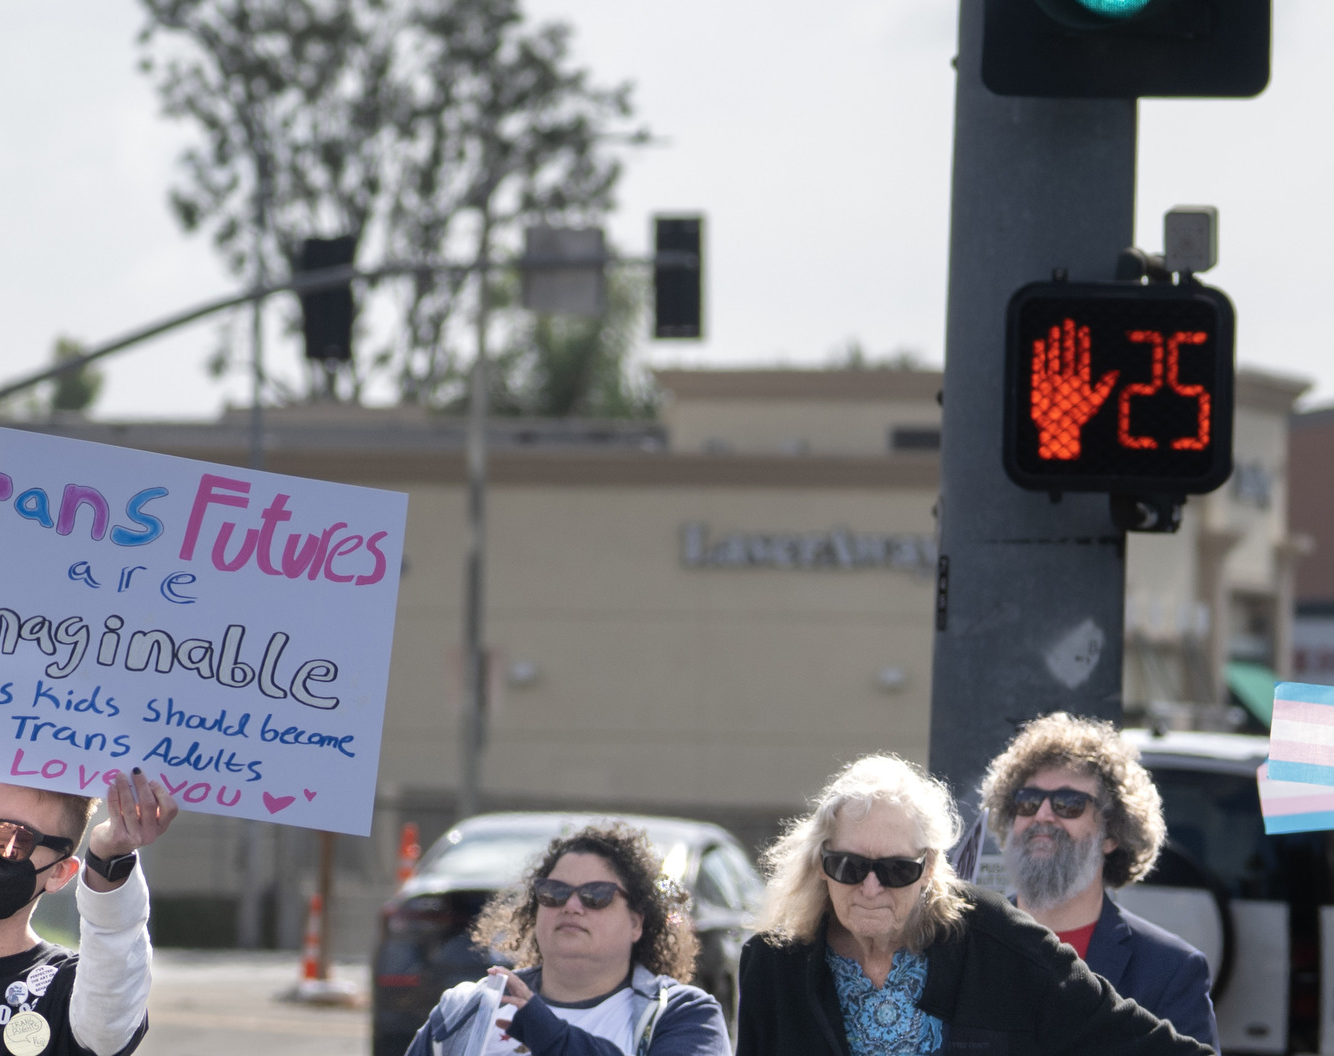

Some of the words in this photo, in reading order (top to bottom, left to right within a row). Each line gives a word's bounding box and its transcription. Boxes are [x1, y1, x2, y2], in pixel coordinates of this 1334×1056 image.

[1117, 330, 1211, 450] 25
[179, 474, 389, 586] Futures
[68, 561, 198, 604] are
[11, 715, 131, 758] Trans
[142, 737, 264, 782] Adults
[261, 716, 356, 758] become
[10, 749, 121, 790] Love
